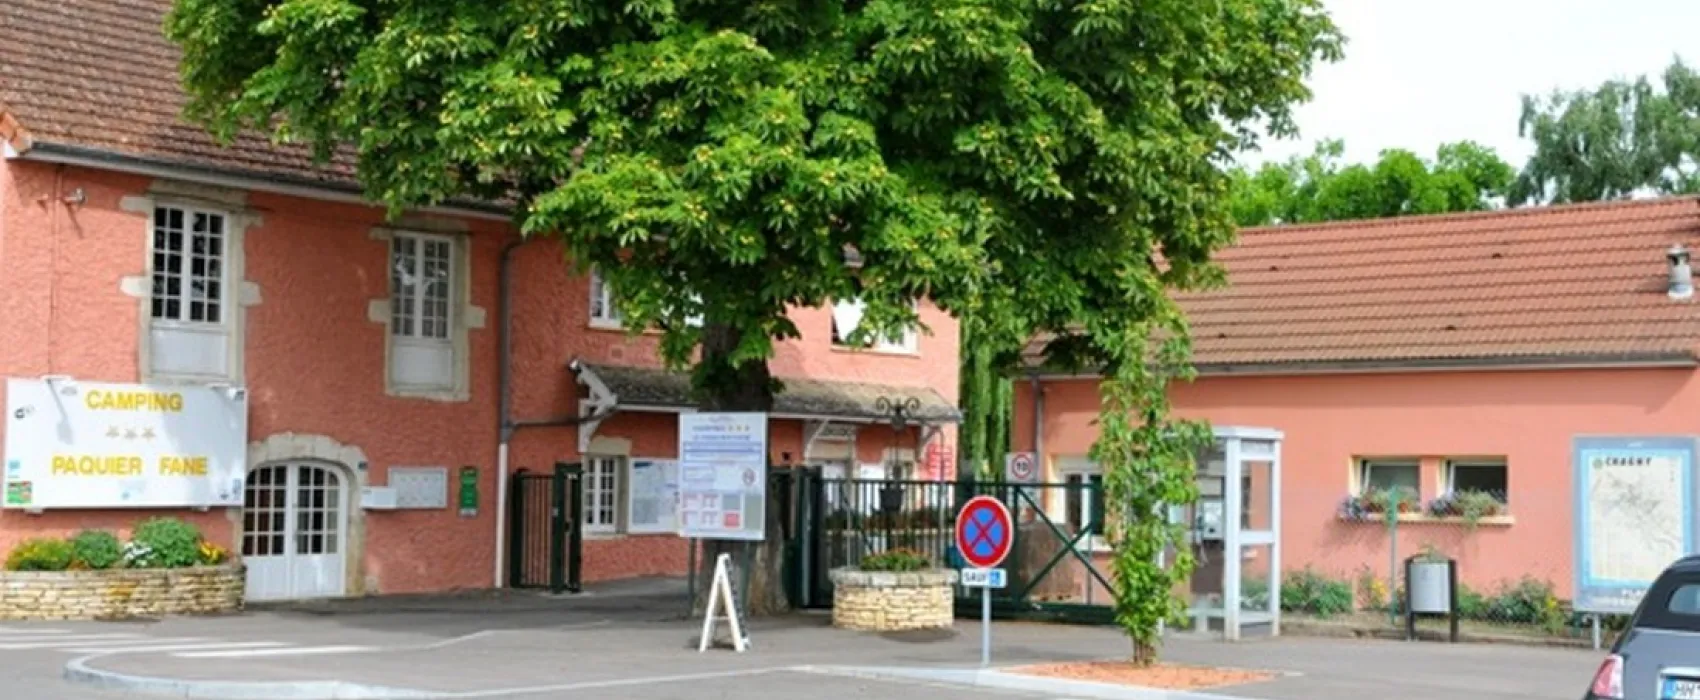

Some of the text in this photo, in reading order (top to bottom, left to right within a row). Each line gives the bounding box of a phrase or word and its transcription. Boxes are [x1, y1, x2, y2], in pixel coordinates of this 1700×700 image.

[86, 390, 183, 411] CAMPING
[52, 456, 208, 475] PAQUIER FANE
[964, 571, 986, 582] SAUF
